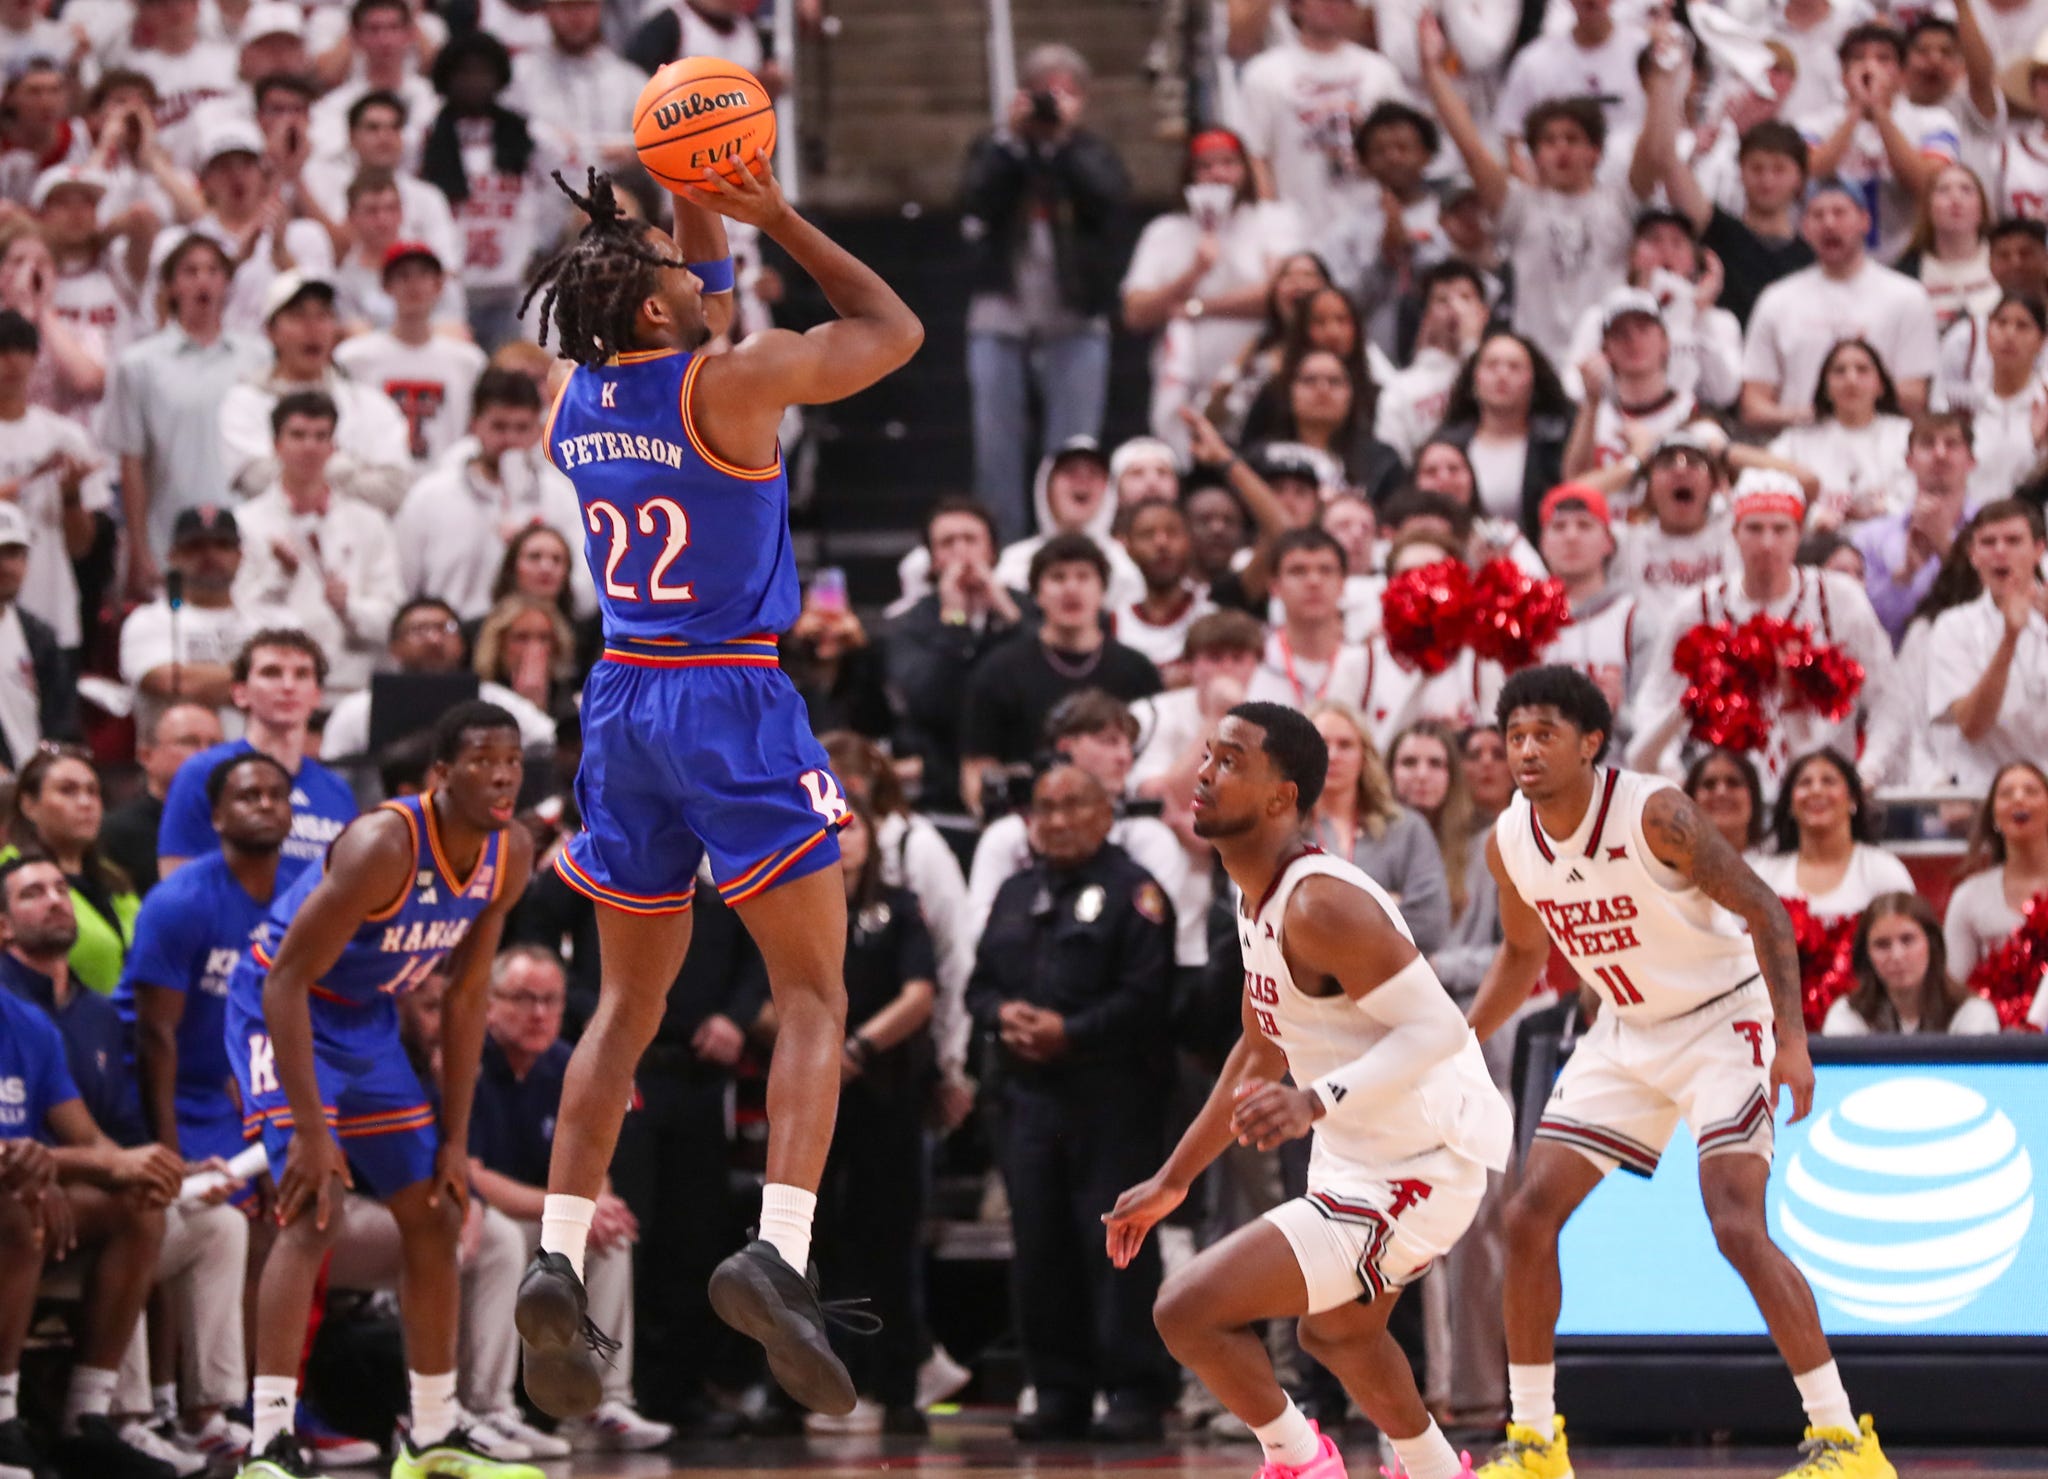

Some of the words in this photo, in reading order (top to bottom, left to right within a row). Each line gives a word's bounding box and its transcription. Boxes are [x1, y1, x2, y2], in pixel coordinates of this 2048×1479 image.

[653, 90, 749, 131] Wilson
[601, 381, 618, 408] K
[558, 431, 684, 470] PETERSON
[584, 495, 698, 604] 22
[1535, 894, 1638, 929] TEXAS
[1555, 924, 1641, 957] TECH
[1594, 964, 1645, 1007] 11
